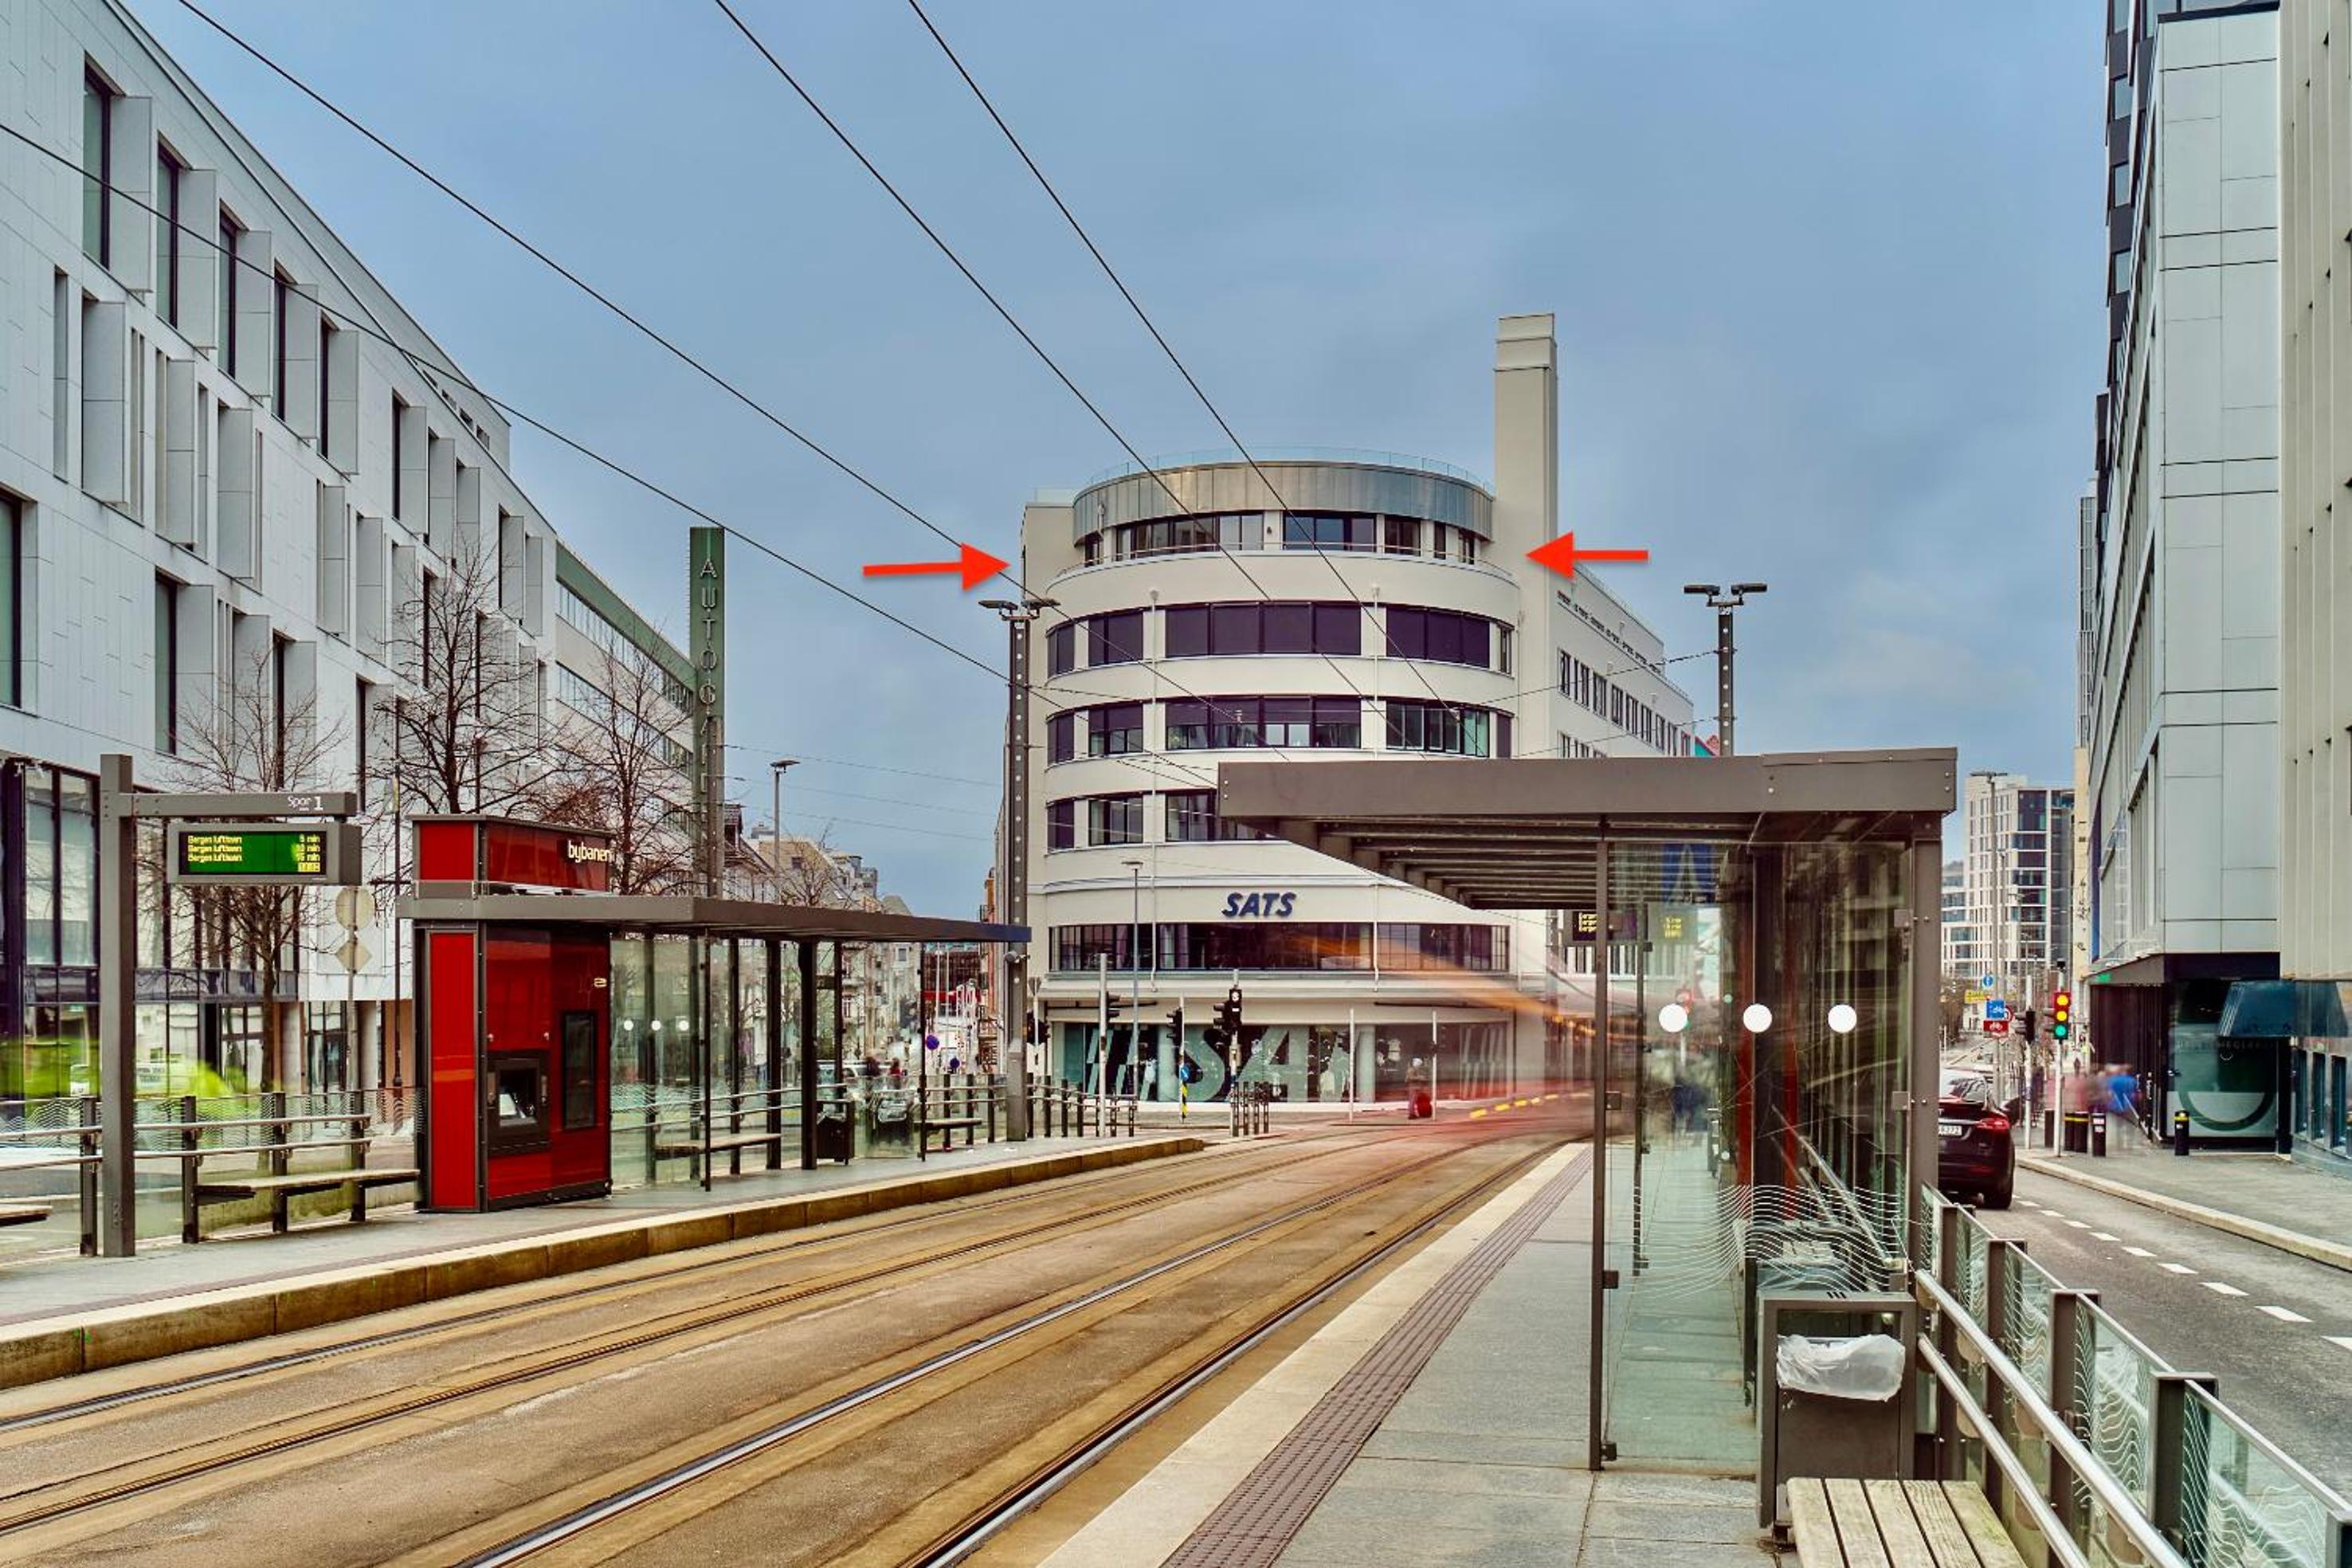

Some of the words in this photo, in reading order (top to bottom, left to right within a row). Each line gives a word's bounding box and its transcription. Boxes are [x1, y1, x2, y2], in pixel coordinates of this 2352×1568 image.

[314, 796, 323, 811] 1
[568, 840, 612, 864] bybanen
[1221, 892, 1296, 917] SATS
